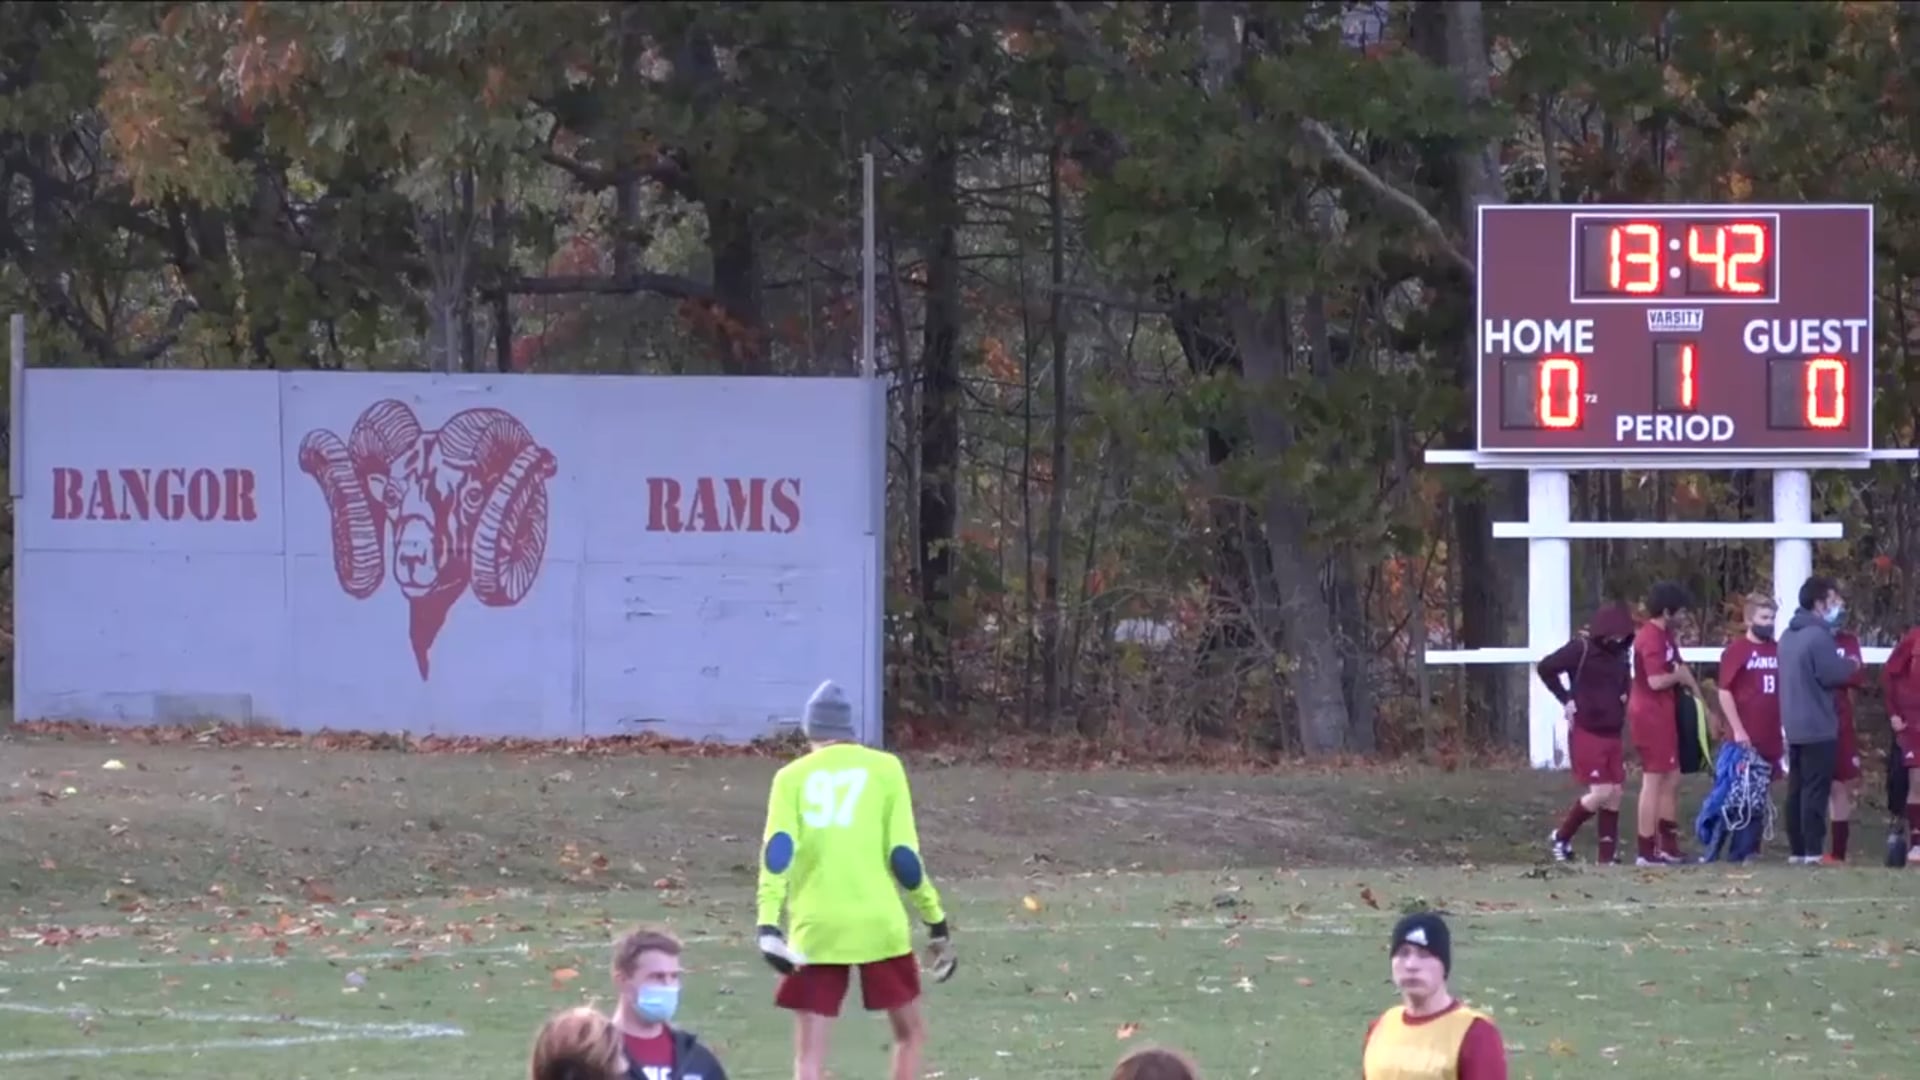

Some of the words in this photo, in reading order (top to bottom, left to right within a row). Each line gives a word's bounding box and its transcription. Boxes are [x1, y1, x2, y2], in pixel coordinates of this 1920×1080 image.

[1609, 223, 1766, 293] 13:42
[1485, 319, 1594, 354] HOME
[1650, 311, 1701, 323] VARSITY
[1743, 319, 1867, 354] GUEST
[1540, 358, 1580, 428] 0
[1680, 345, 1693, 408] 1
[1806, 358, 1846, 428] 0
[1615, 415, 1735, 442] PERIOD
[51, 466, 258, 523] BANGOR
[645, 476, 802, 534] RAMS
[1763, 674, 1775, 693] 13
[802, 767, 869, 829] 97
